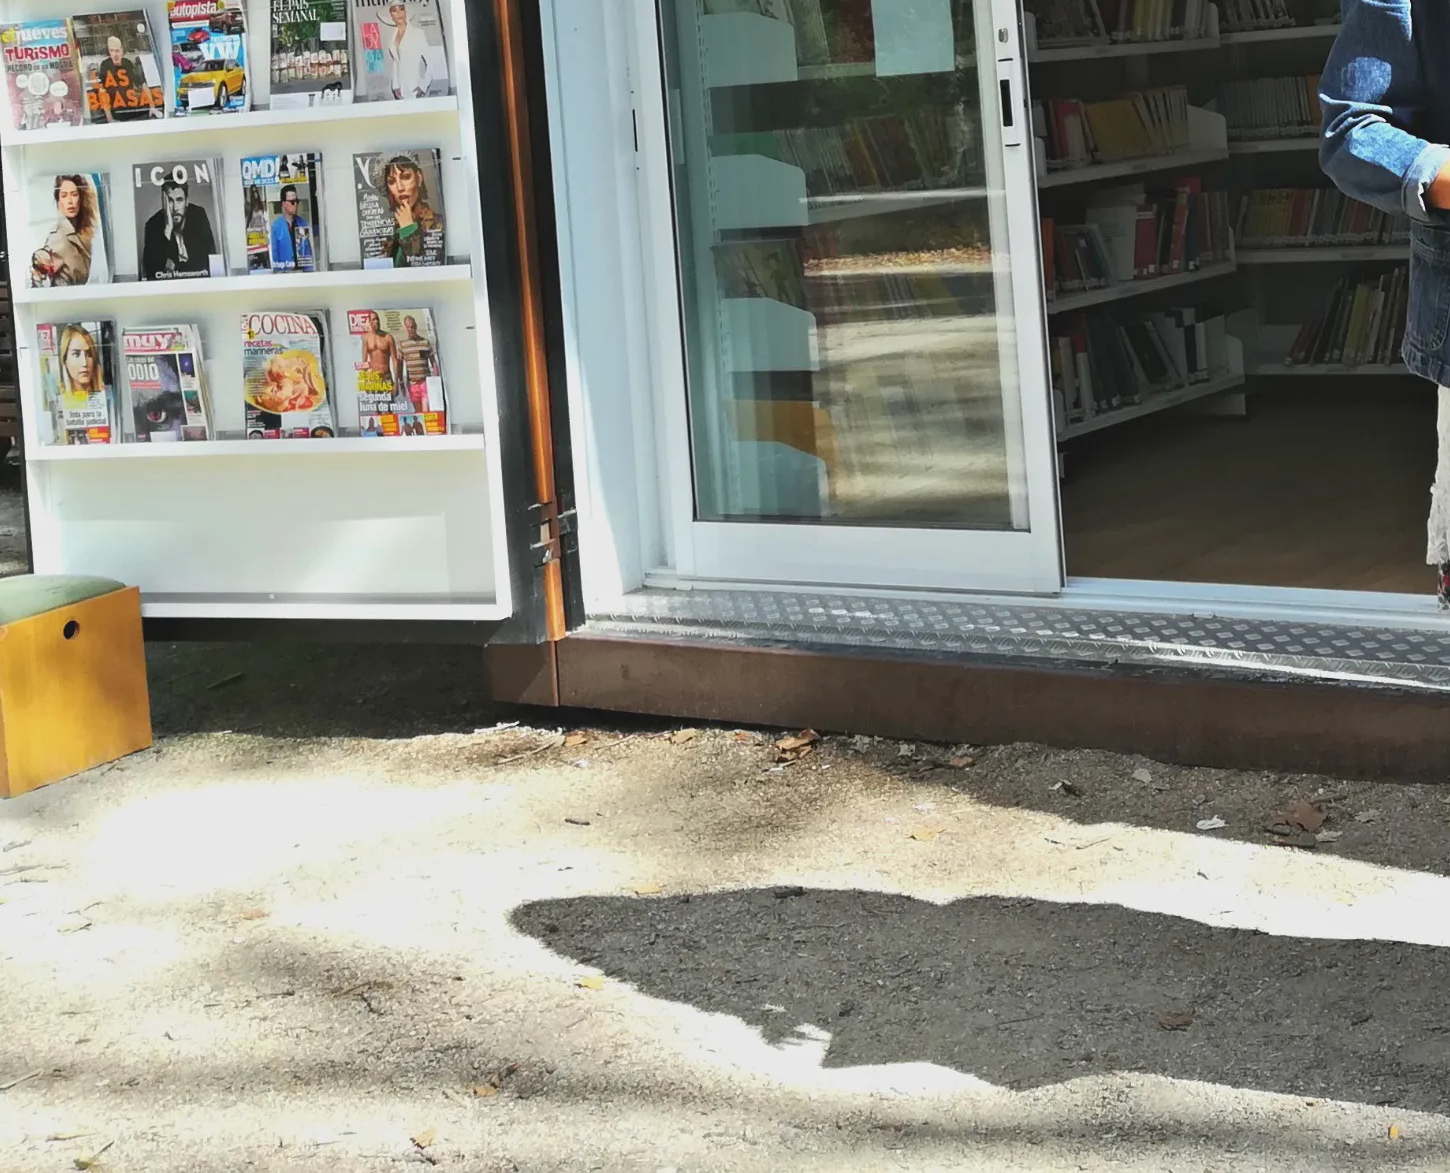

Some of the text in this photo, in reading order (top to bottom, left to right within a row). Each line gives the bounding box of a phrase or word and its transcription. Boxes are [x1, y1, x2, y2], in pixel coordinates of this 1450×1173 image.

[170, 1, 218, 19] autopista
[272, 8, 320, 24] SEMANAL
[88, 87, 165, 112] BRASAS
[135, 164, 210, 187] ICON
[155, 270, 173, 279] Chris
[249, 313, 318, 336] COCINA
[123, 333, 172, 350] muy
[244, 339, 272, 349] recetas
[127, 363, 160, 381] ODIO
[359, 392, 392, 404] segunda
[359, 400, 408, 413] luna de miel
